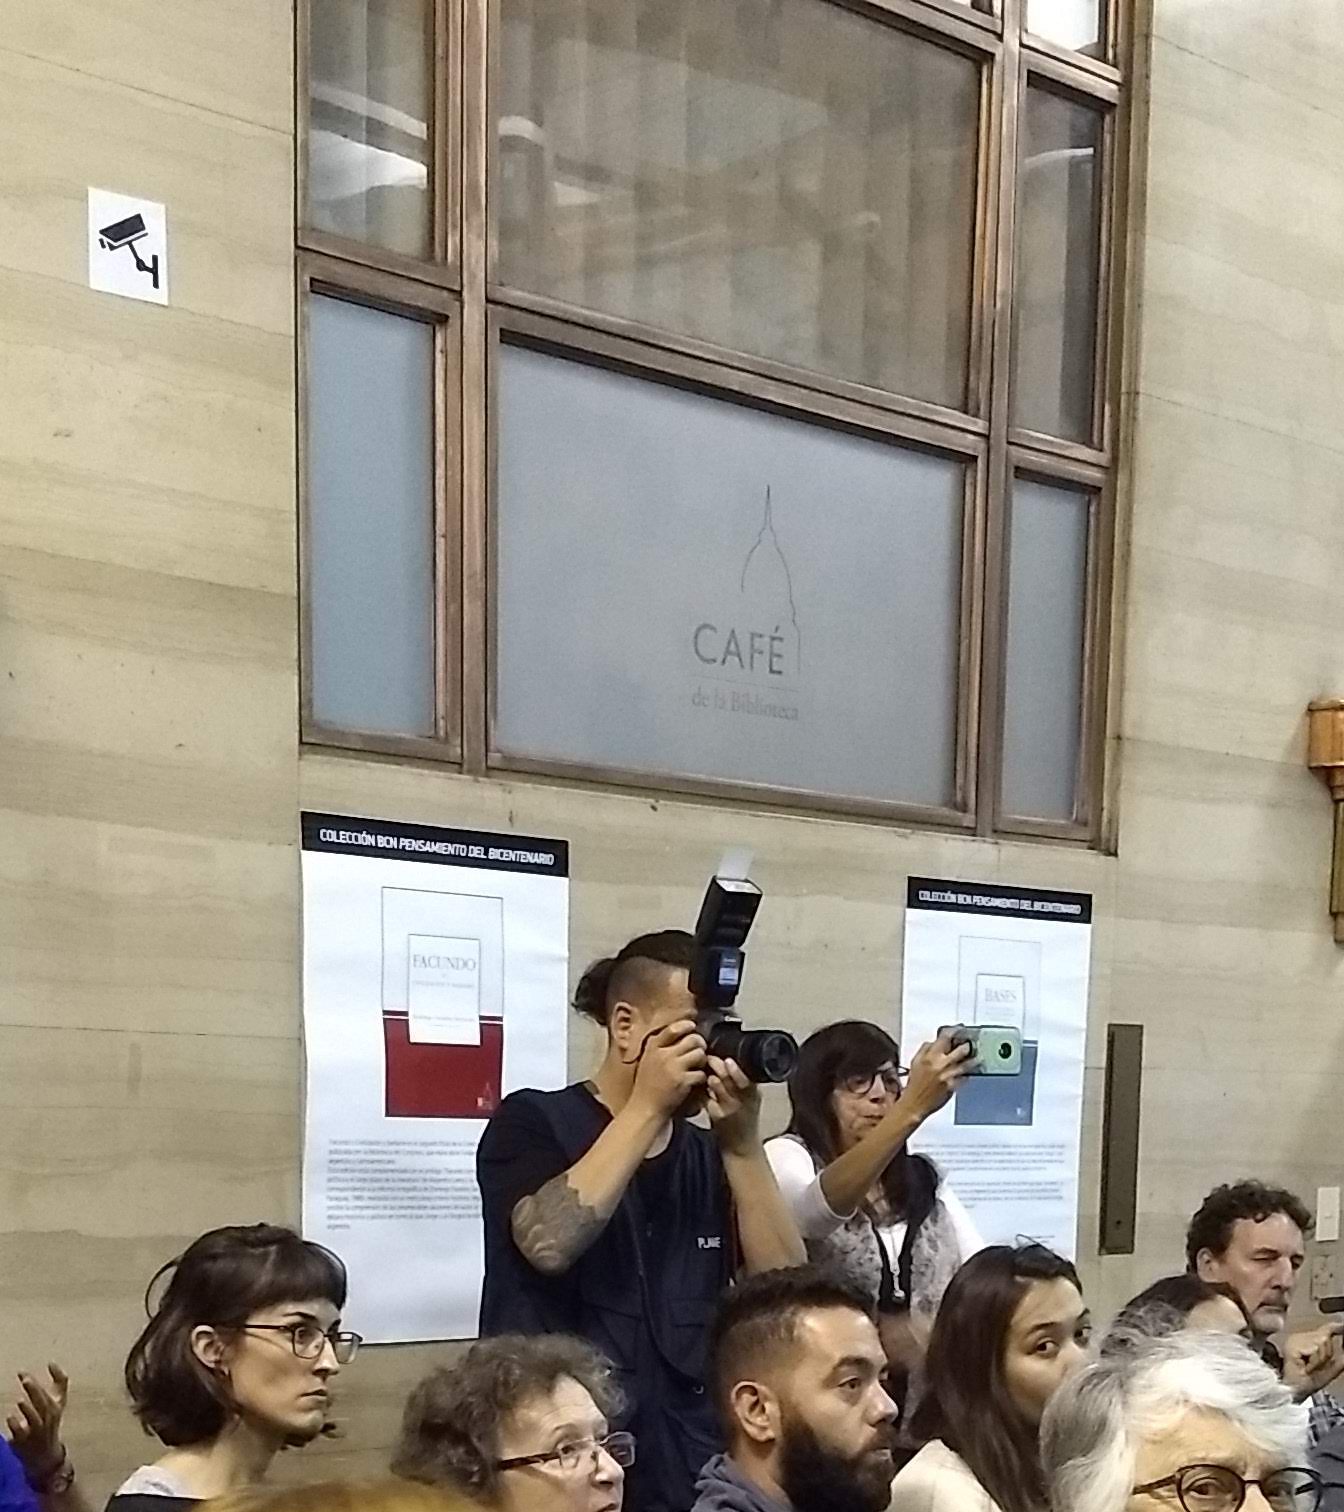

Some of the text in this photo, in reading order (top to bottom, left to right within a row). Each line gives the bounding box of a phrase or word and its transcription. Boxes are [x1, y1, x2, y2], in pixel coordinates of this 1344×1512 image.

[693, 624, 784, 675] CAFÉ
[691, 686, 709, 707] de
[730, 691, 799, 721] Biblioteca
[319, 828, 555, 866] COLECCIÓN BCN PENSAMIENTO DEL BICENTENARIO
[412, 953, 477, 972] FACUNDO
